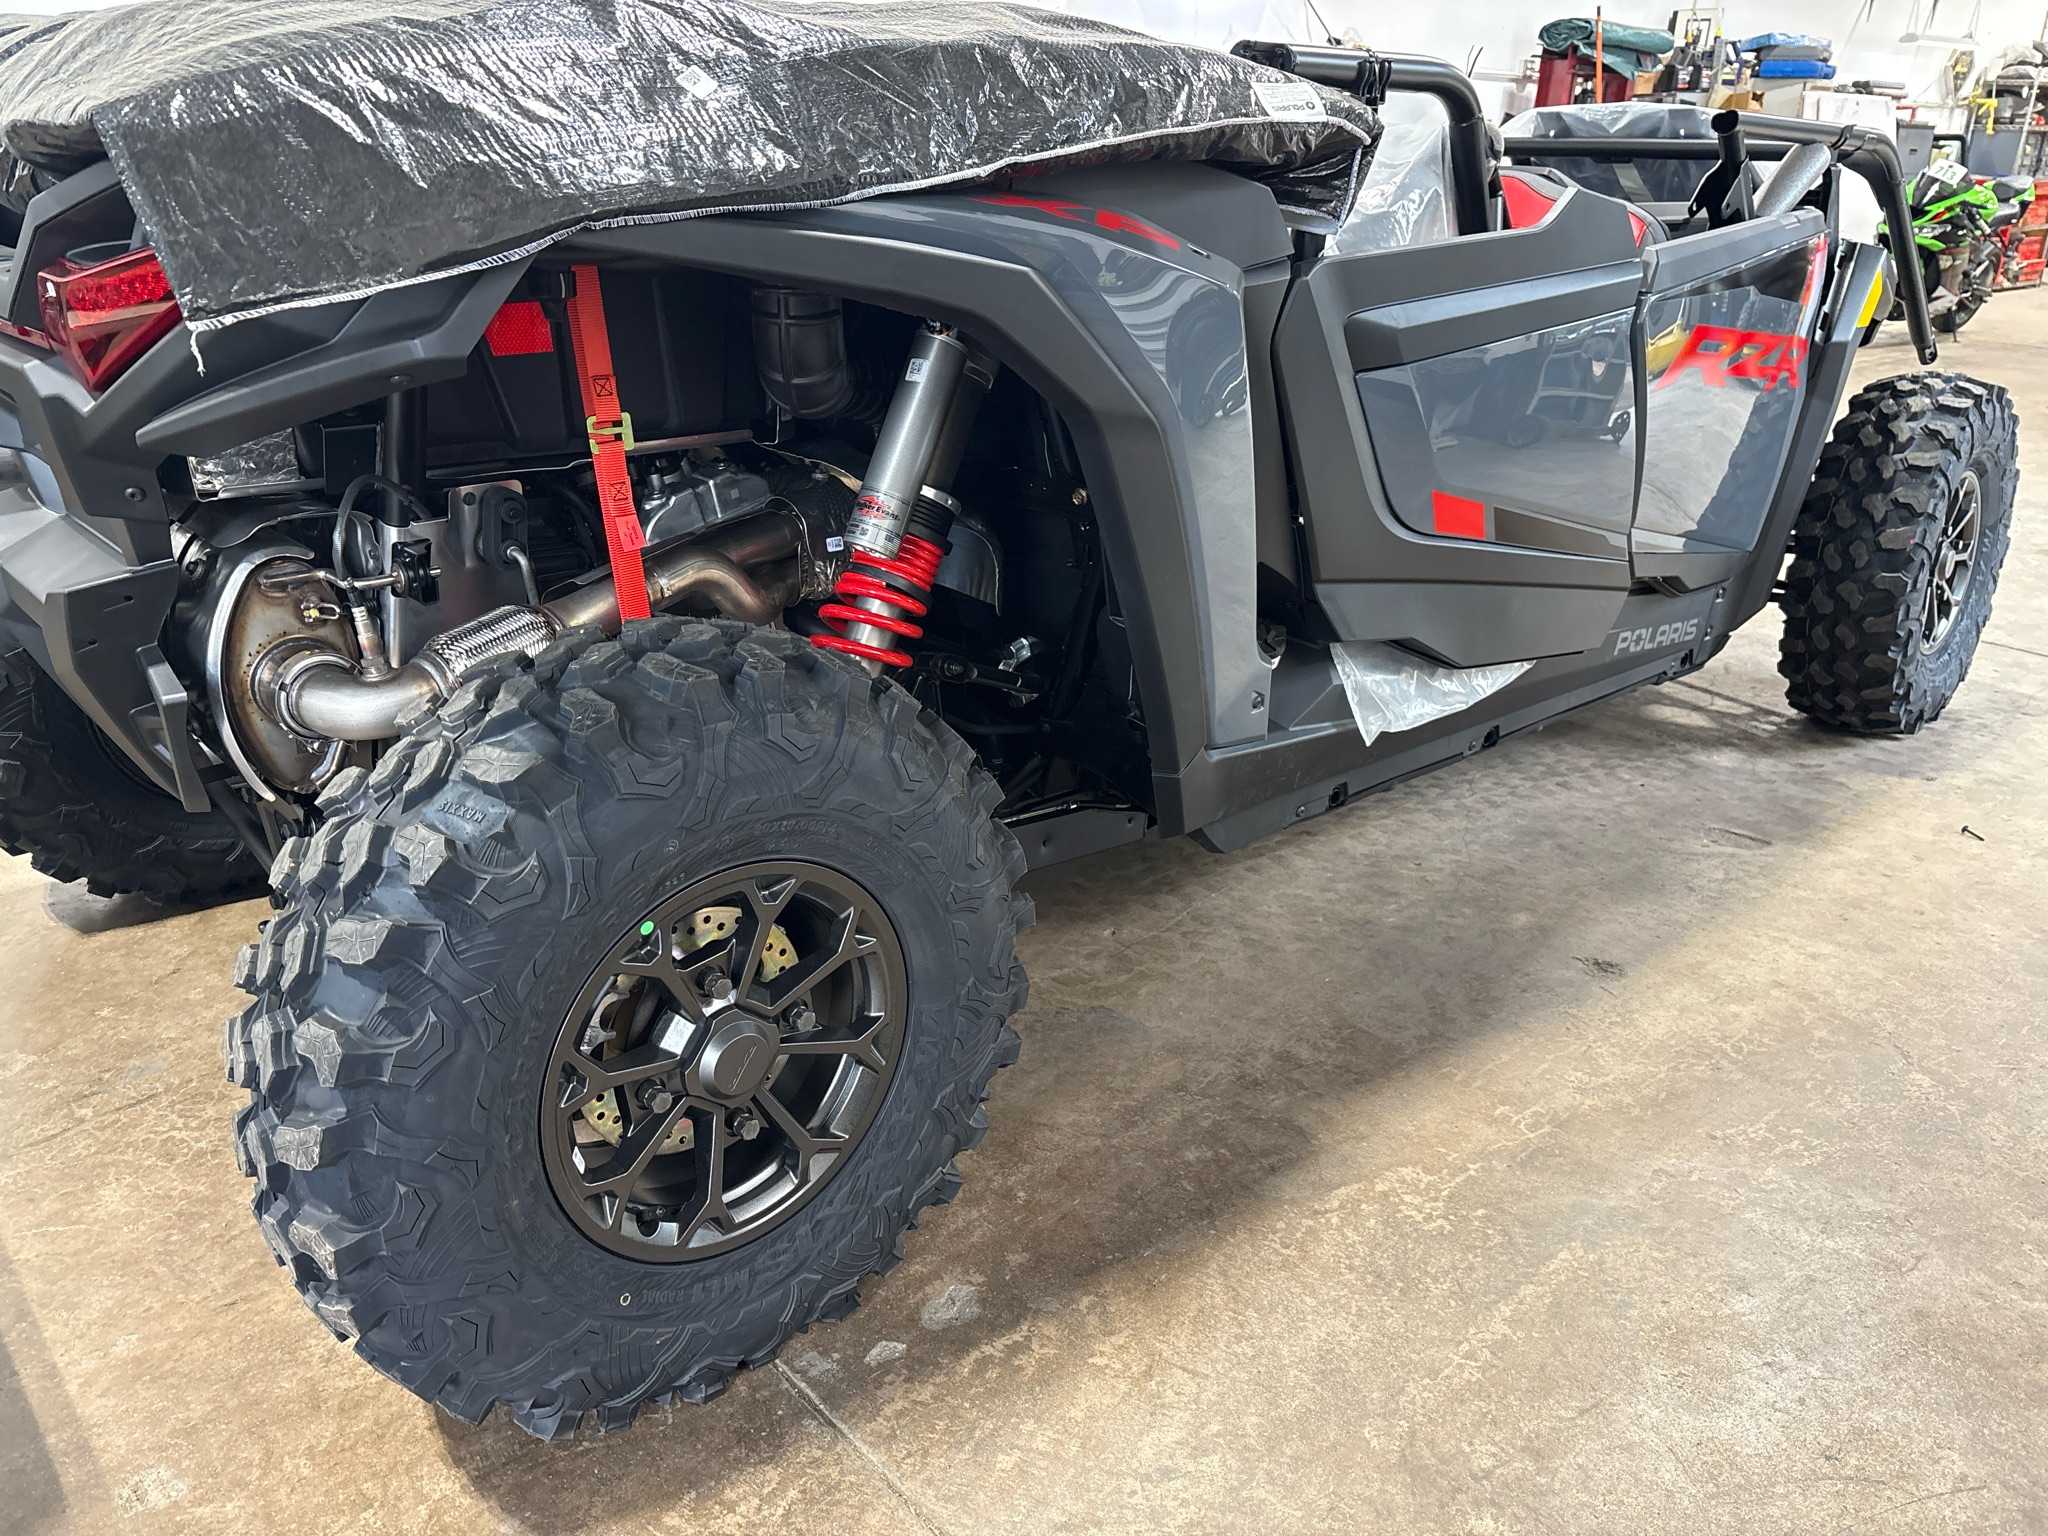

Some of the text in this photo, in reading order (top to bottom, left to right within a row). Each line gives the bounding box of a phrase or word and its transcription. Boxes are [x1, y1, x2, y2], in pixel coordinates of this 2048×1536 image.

[1934, 165, 1957, 181] 713
[972, 191, 1181, 252] XP
[1653, 323, 1809, 394] RZR
[1613, 617, 1699, 656] POLARIS
[437, 800, 487, 824] MAXXIS
[641, 1288, 686, 1305] RADIAL
